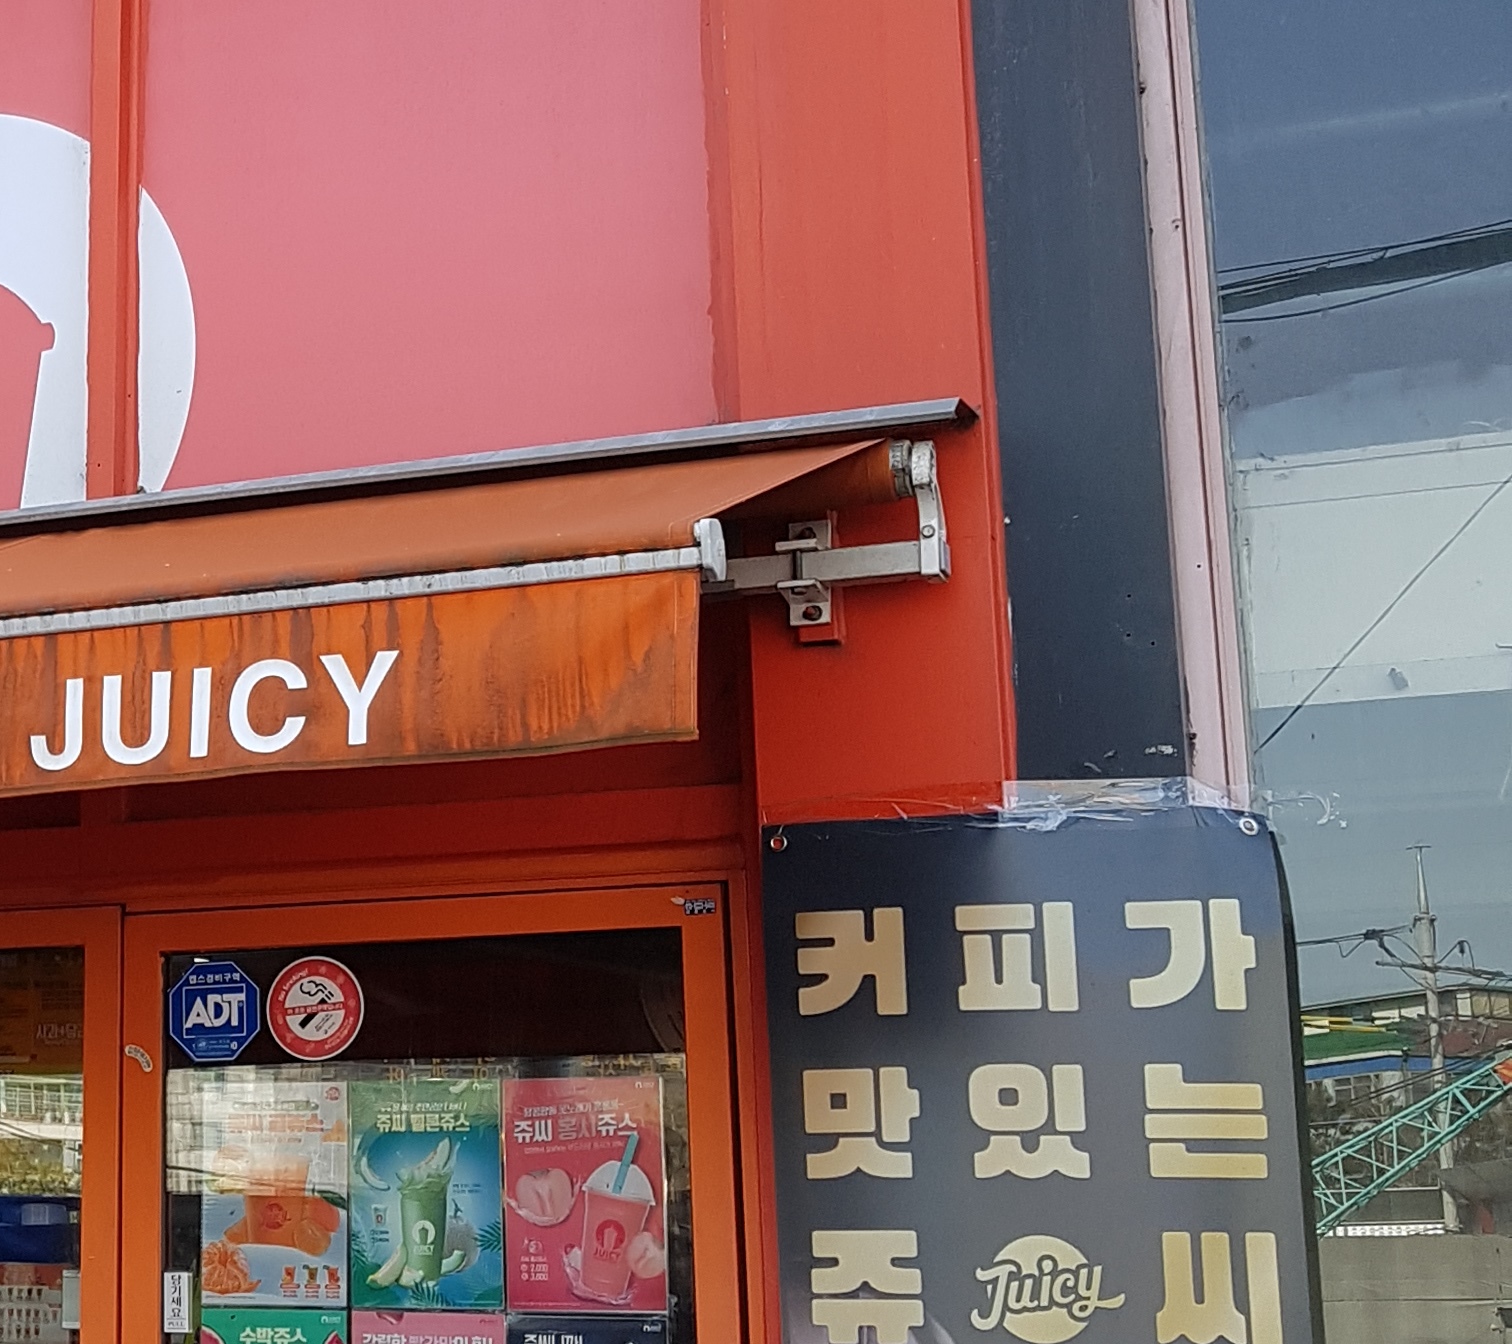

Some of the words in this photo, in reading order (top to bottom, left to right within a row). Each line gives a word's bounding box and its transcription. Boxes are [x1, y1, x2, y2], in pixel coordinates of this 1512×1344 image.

[29, 649, 400, 772] JUICY
[184, 992, 245, 1028] ADT
[376, 1113, 406, 1133] 쥬씨
[513, 1118, 553, 1144] 쥬씨
[170, 1274, 181, 1317] 당기세요
[970, 1252, 1126, 1331] Juicy
